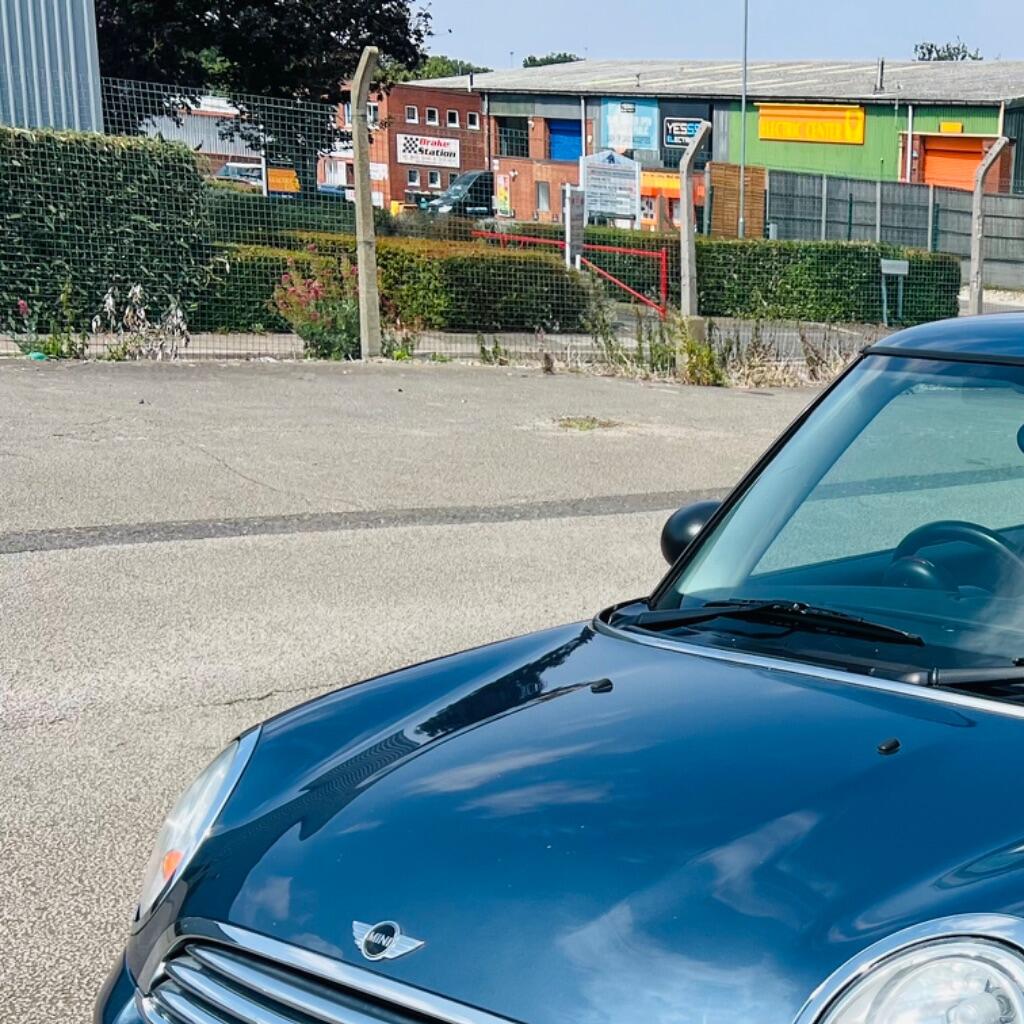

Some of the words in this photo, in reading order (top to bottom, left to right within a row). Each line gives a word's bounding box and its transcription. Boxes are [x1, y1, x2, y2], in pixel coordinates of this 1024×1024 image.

[419, 137, 450, 148] Brake
[418, 147, 456, 158] Station
[366, 931, 396, 947] MINI
